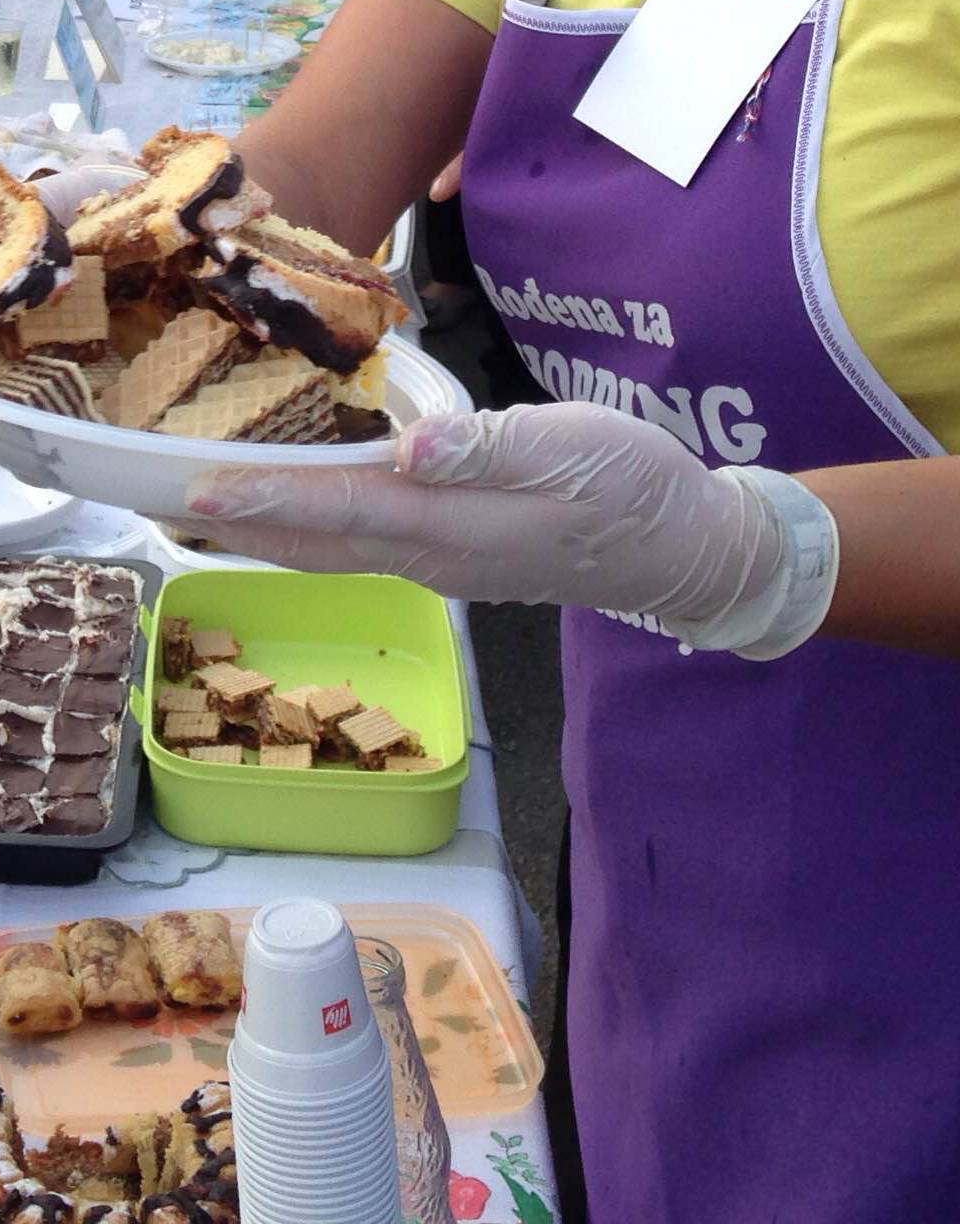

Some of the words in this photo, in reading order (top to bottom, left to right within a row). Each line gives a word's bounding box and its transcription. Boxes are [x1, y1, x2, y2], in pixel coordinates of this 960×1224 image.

[623, 300, 675, 349] za
[514, 340, 768, 464] HOPPING
[325, 1004, 348, 1030] illy
